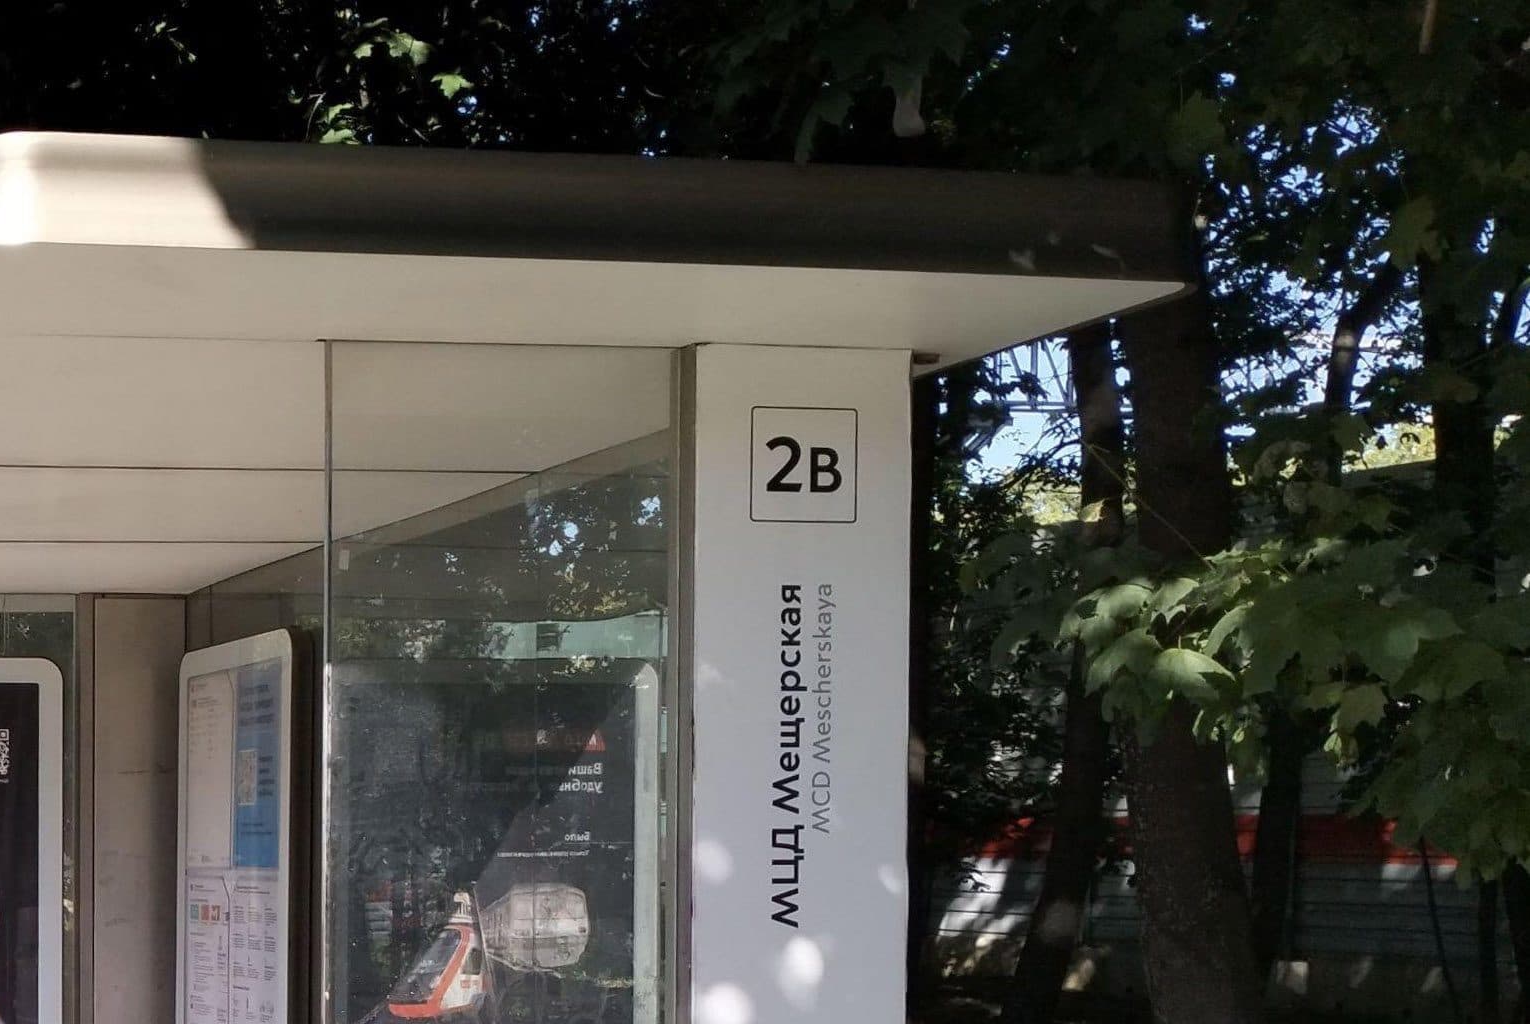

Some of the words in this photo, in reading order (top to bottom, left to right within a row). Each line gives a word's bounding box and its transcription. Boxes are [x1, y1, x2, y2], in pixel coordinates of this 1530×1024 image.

[771, 584, 808, 814] Мещерская
[811, 583, 837, 764] Mescherskaya
[811, 771, 831, 834] MCD
[771, 825, 805, 928] МЦД
